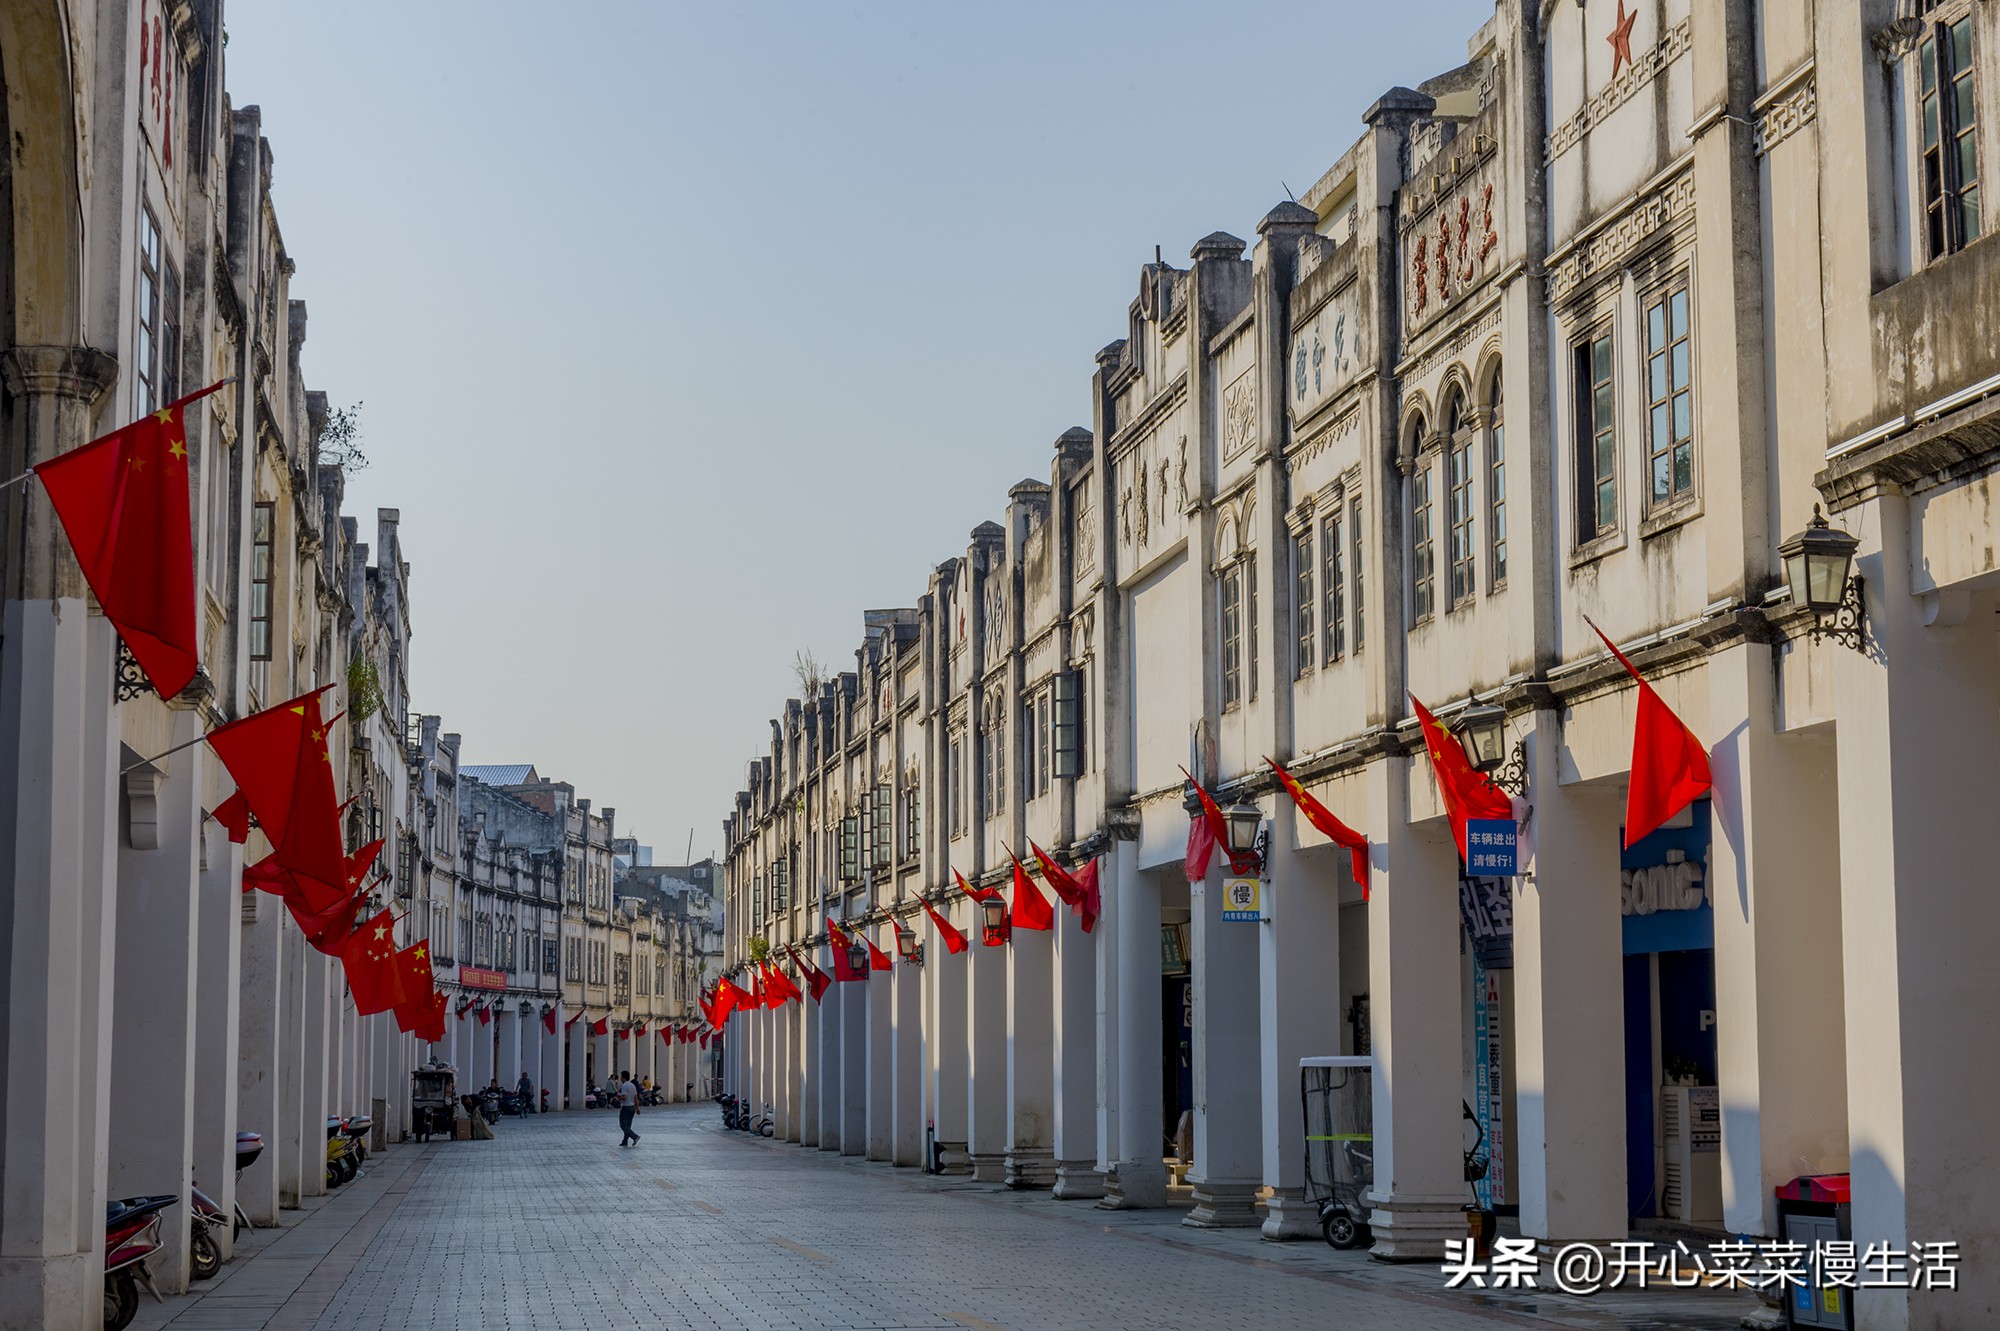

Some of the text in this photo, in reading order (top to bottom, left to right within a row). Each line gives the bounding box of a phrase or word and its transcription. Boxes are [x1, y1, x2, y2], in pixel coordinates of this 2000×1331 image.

[1470, 832, 1516, 846] 车辆进出
[1473, 854, 1512, 867] 请慢行!
[1233, 886, 1250, 904] 慢
[1488, 1017, 1501, 1122] 三菱重工
